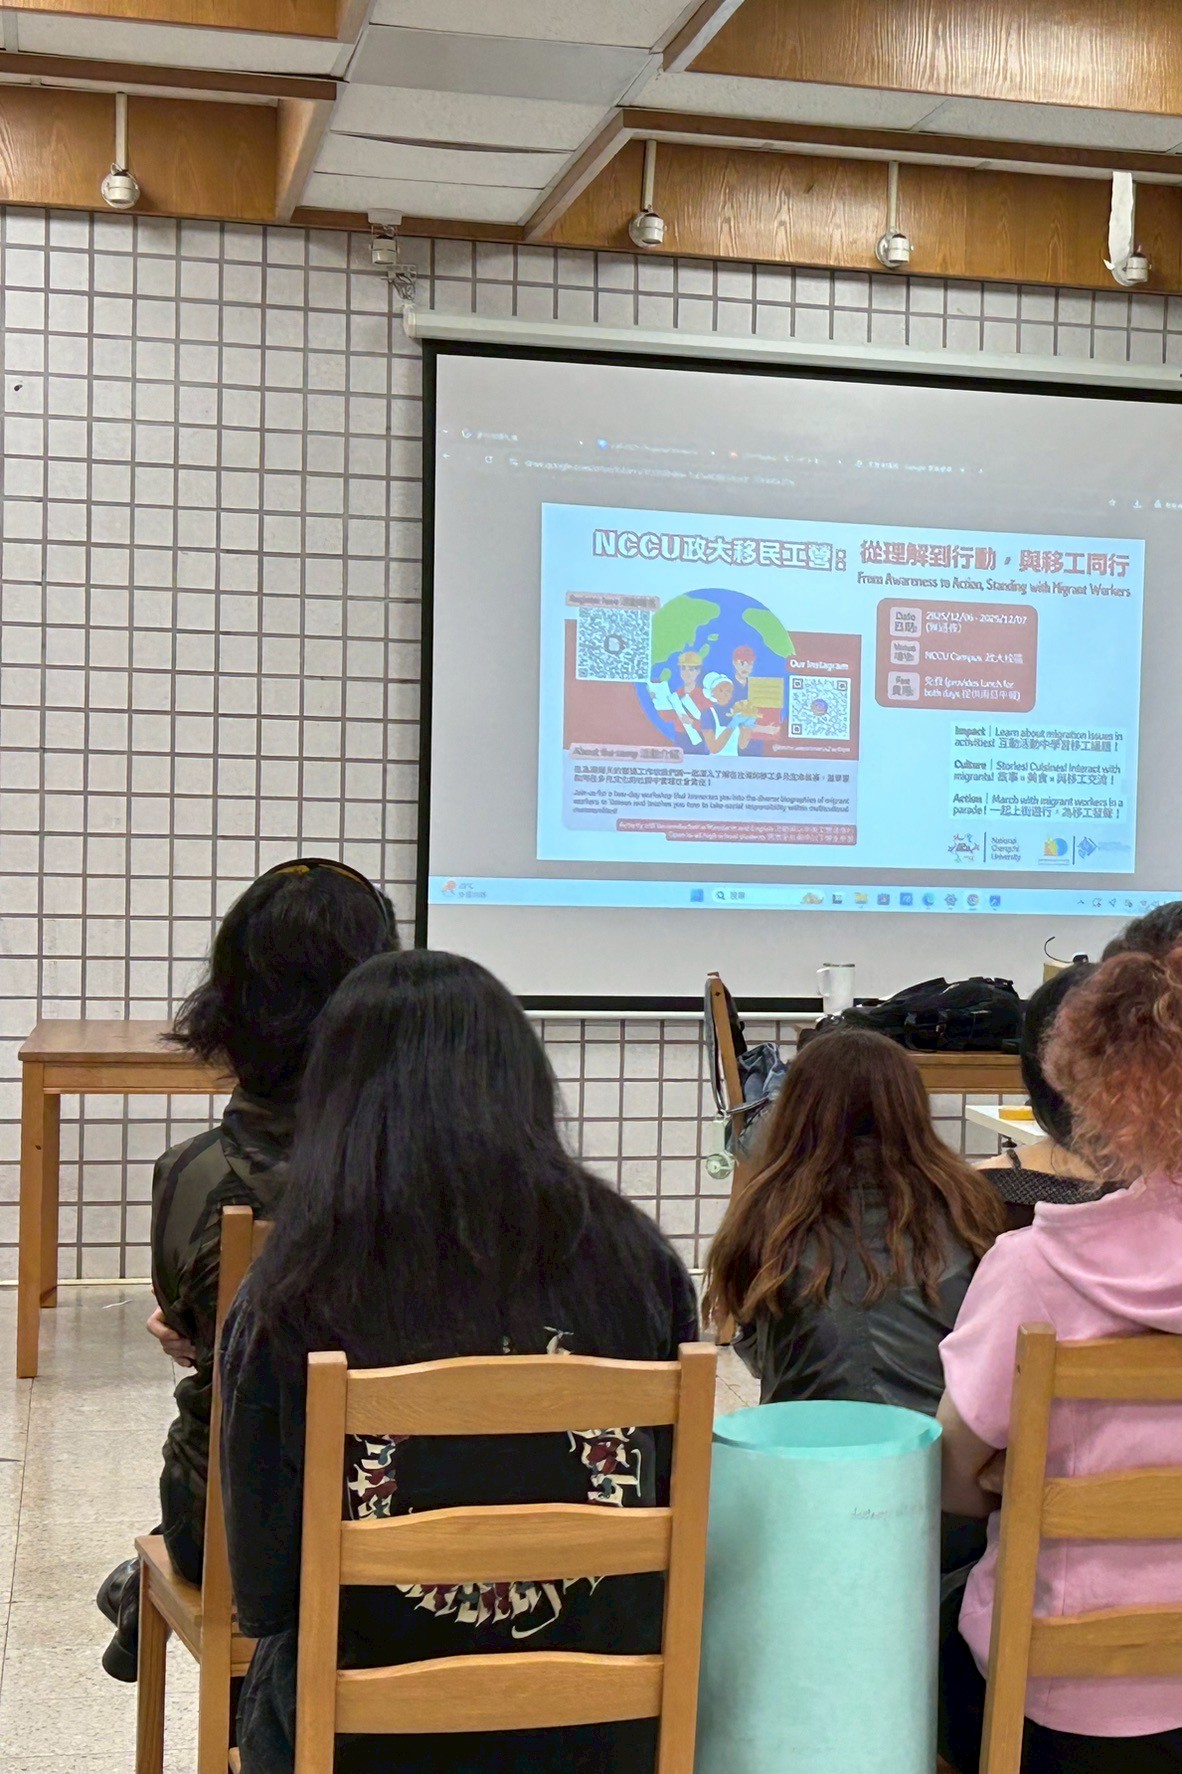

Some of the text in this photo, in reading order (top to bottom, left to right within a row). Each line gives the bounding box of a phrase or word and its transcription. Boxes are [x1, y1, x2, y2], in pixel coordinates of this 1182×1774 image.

[859, 540, 1130, 577] 從理解到行動，與移工同行
[857, 571, 1131, 597] From Awareness to Action, Standing with Migrant Workers
[790, 660, 848, 671] Our Instagram
[955, 725, 986, 738] Impact
[995, 727, 1019, 737] Learn
[1020, 728, 1045, 738] about
[1046, 729, 1087, 740] migration
[954, 759, 987, 770] Culture
[1102, 764, 1121, 774] with
[952, 793, 982, 804] Action
[992, 794, 1019, 804] March
[1020, 795, 1039, 804] with
[1040, 796, 1074, 809] migrant
[1074, 797, 1107, 806] workers
